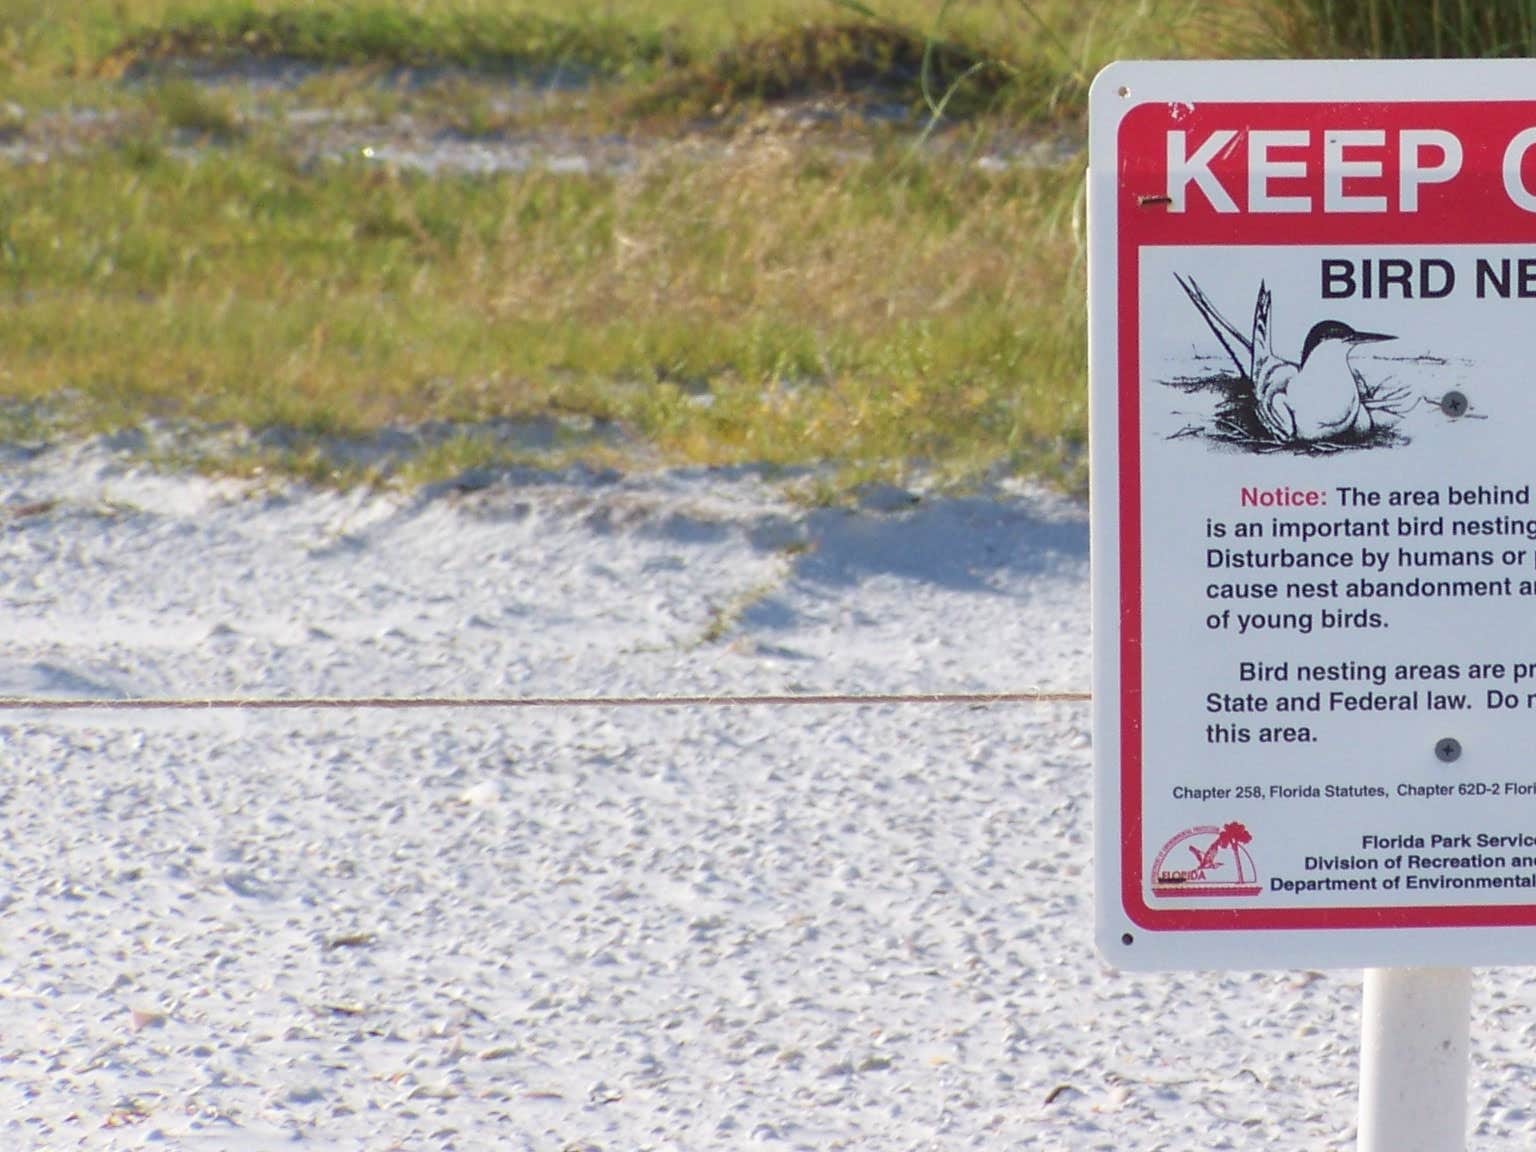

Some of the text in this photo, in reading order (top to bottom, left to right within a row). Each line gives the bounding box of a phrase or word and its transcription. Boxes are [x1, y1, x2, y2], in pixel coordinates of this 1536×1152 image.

[1167, 130, 1463, 212] KEEP
[1322, 259, 1455, 298] BIRD
[1241, 487, 1326, 506] Notice:
[1336, 487, 1381, 506] The
[1389, 491, 1439, 506] area
[1449, 485, 1529, 505] behind
[1207, 518, 1226, 538] is
[1235, 523, 1263, 537] an
[1273, 518, 1389, 542] important
[1398, 517, 1443, 536] bird
[1207, 548, 1353, 568] Disturbance
[1362, 548, 1389, 572] by
[1399, 547, 1494, 566] humans
[1502, 550, 1526, 565] or
[1207, 584, 1278, 599] cause
[1287, 579, 1338, 598] nest
[1346, 578, 1512, 598] abandonment
[1207, 609, 1388, 634] of young birds.
[1240, 662, 1288, 681] Bird
[1298, 661, 1386, 685] nesting
[1395, 665, 1460, 680] areas
[1468, 664, 1505, 679] are
[1207, 693, 1268, 712] State
[1276, 692, 1320, 712] and
[1330, 691, 1417, 711] Federal
[1428, 691, 1471, 710] law.
[1487, 690, 1519, 709] Do
[1206, 724, 1317, 743] this area.
[1173, 786, 1231, 802] Chapter
[1235, 786, 1265, 800] 258,
[1270, 785, 1320, 798] Florida
[1325, 785, 1389, 798] Statutes,
[1397, 784, 1455, 799] Chapter
[1458, 783, 1500, 795] 62D-2
[1362, 835, 1424, 849] Florida
[1431, 834, 1471, 848] Park
[1305, 856, 1378, 870] Division
[1384, 855, 1402, 869] of
[1408, 854, 1505, 869] Recreation
[1271, 877, 1377, 894] Department
[1382, 876, 1400, 889] of
[1406, 874, 1536, 889] Environmental
